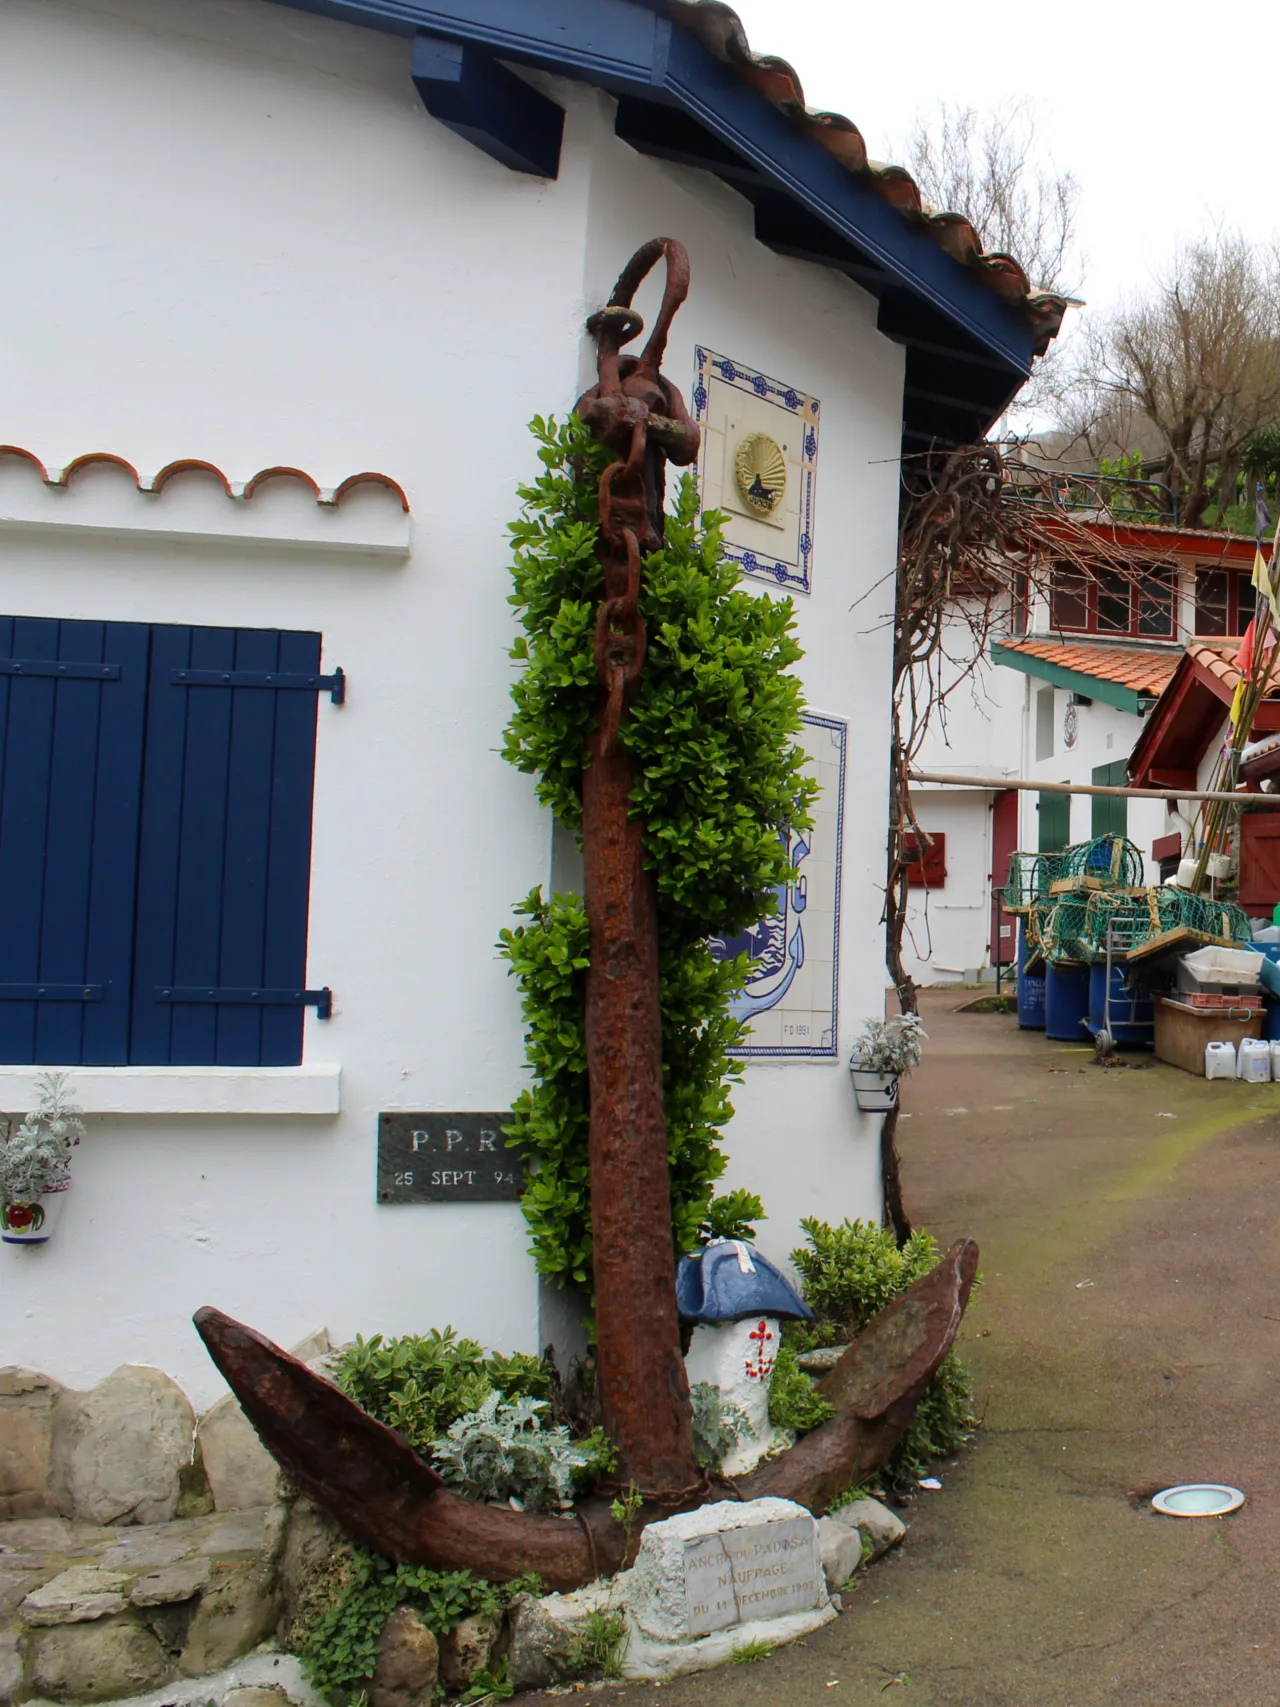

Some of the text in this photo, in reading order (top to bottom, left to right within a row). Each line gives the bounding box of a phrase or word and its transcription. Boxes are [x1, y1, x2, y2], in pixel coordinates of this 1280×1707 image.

[395, 1171, 414, 1185] 25
[431, 1170, 476, 1185] SEPT
[718, 1561, 788, 1587] NAUFRAGE
[693, 1604, 709, 1617] DU
